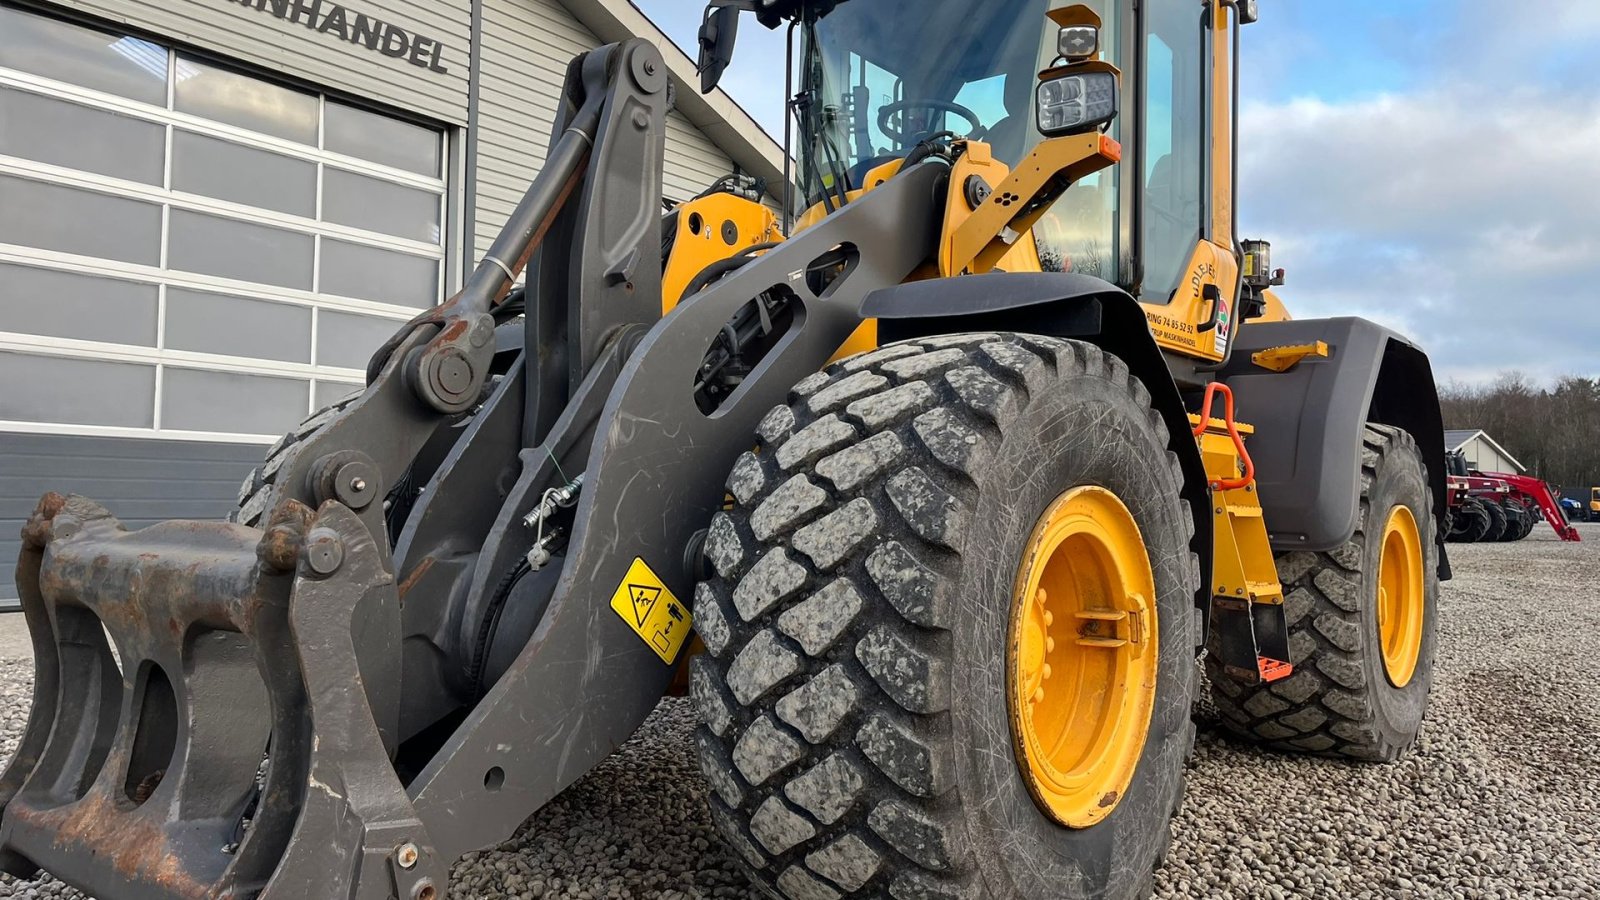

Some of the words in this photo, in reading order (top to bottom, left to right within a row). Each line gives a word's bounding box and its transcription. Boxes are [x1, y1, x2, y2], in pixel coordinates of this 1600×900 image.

[1146, 312, 1162, 325] RING
[1163, 317, 1170, 327] 74
[1171, 319, 1179, 330] 85
[1180, 323, 1187, 332] 52
[1187, 325, 1194, 334] 92
